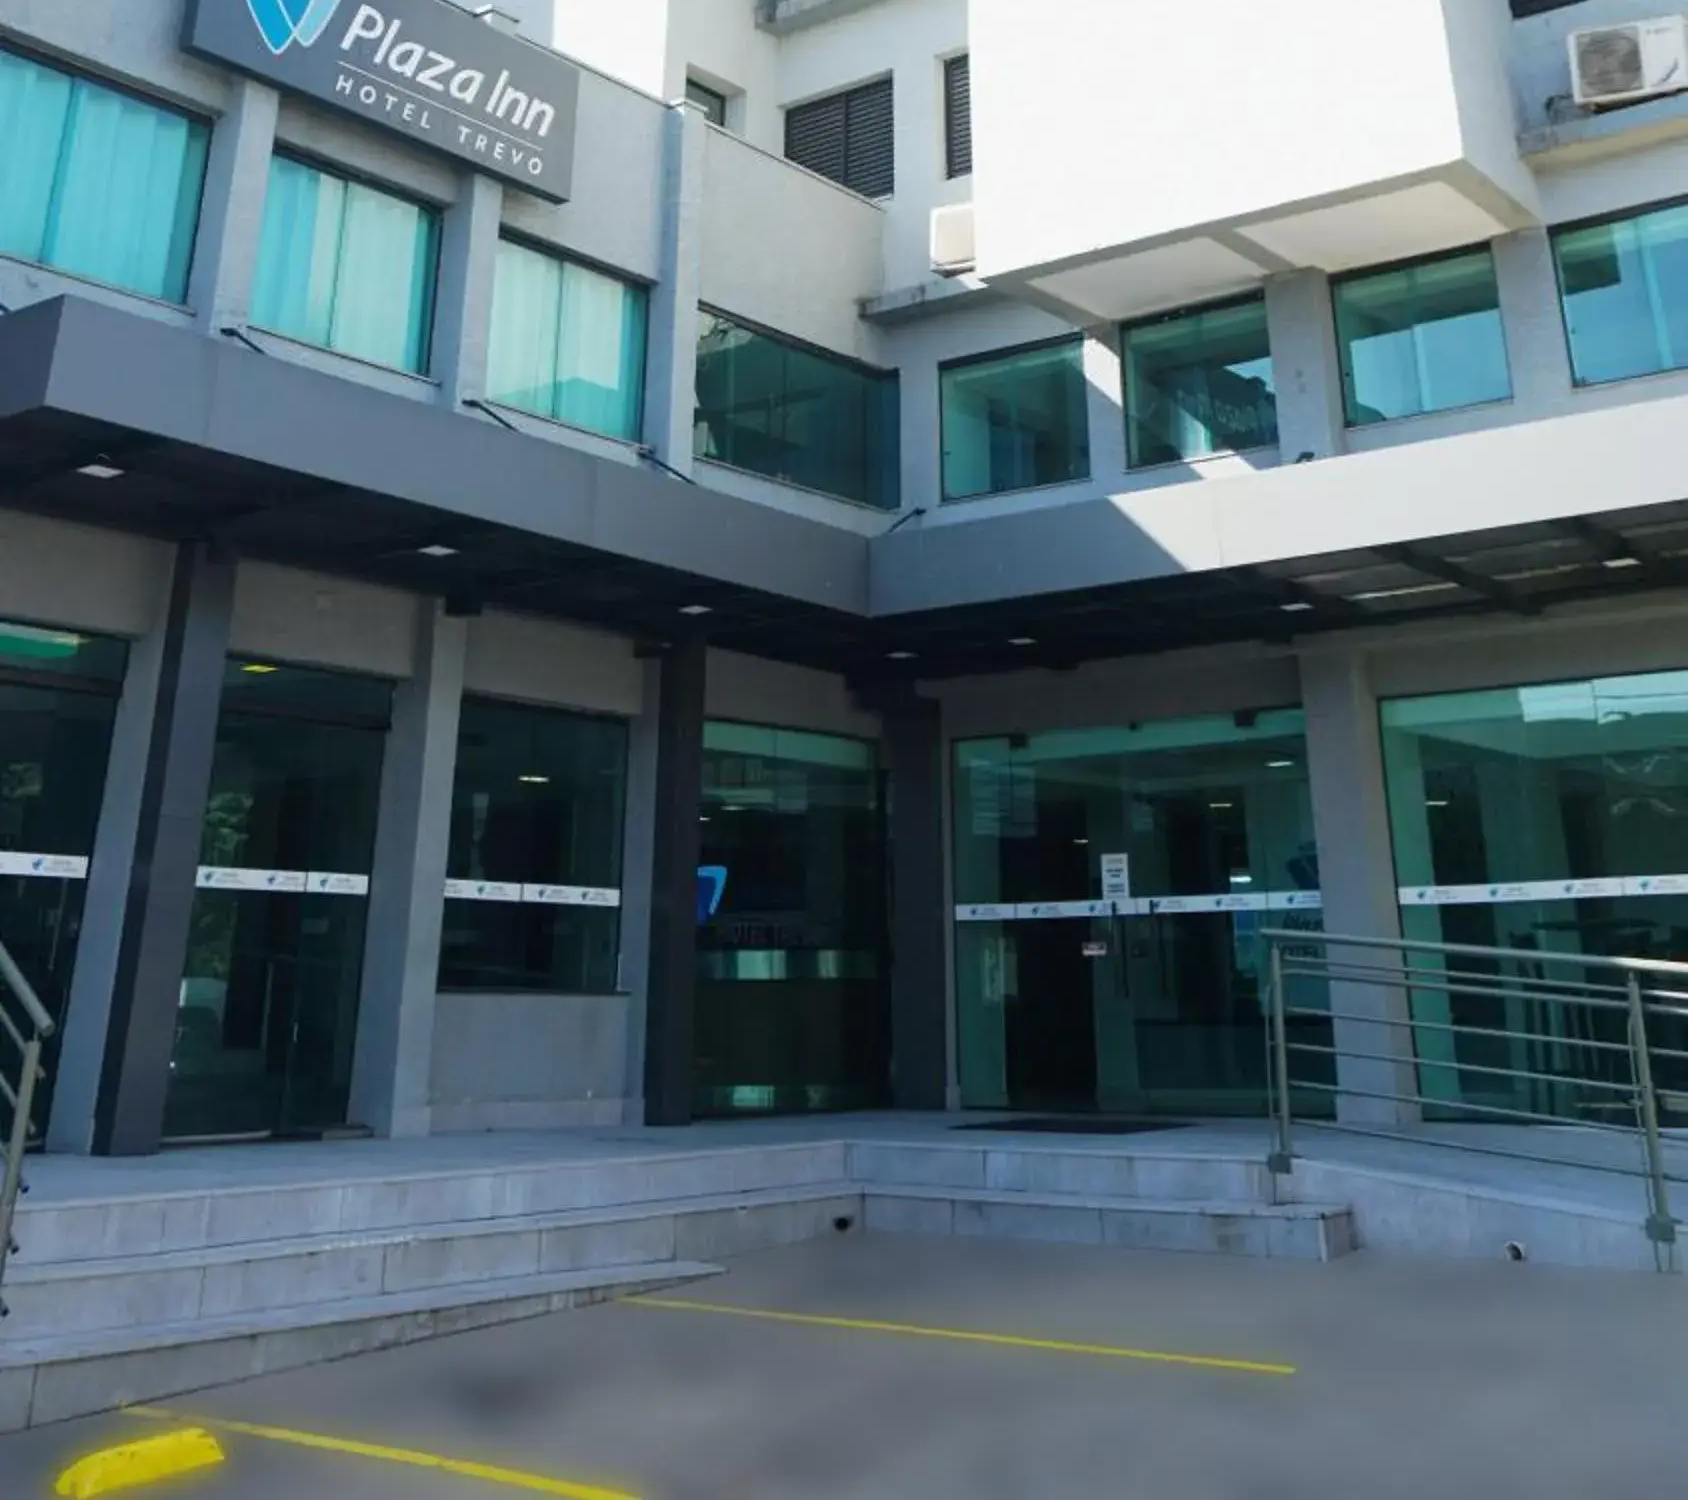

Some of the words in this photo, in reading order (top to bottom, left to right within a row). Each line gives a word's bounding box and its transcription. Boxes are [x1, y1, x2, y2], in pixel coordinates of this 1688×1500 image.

[336, 75, 431, 129] HOTEL
[458, 126, 543, 175] TREVO
[341, 4, 486, 103] Plaza
[485, 70, 555, 137] Inn
